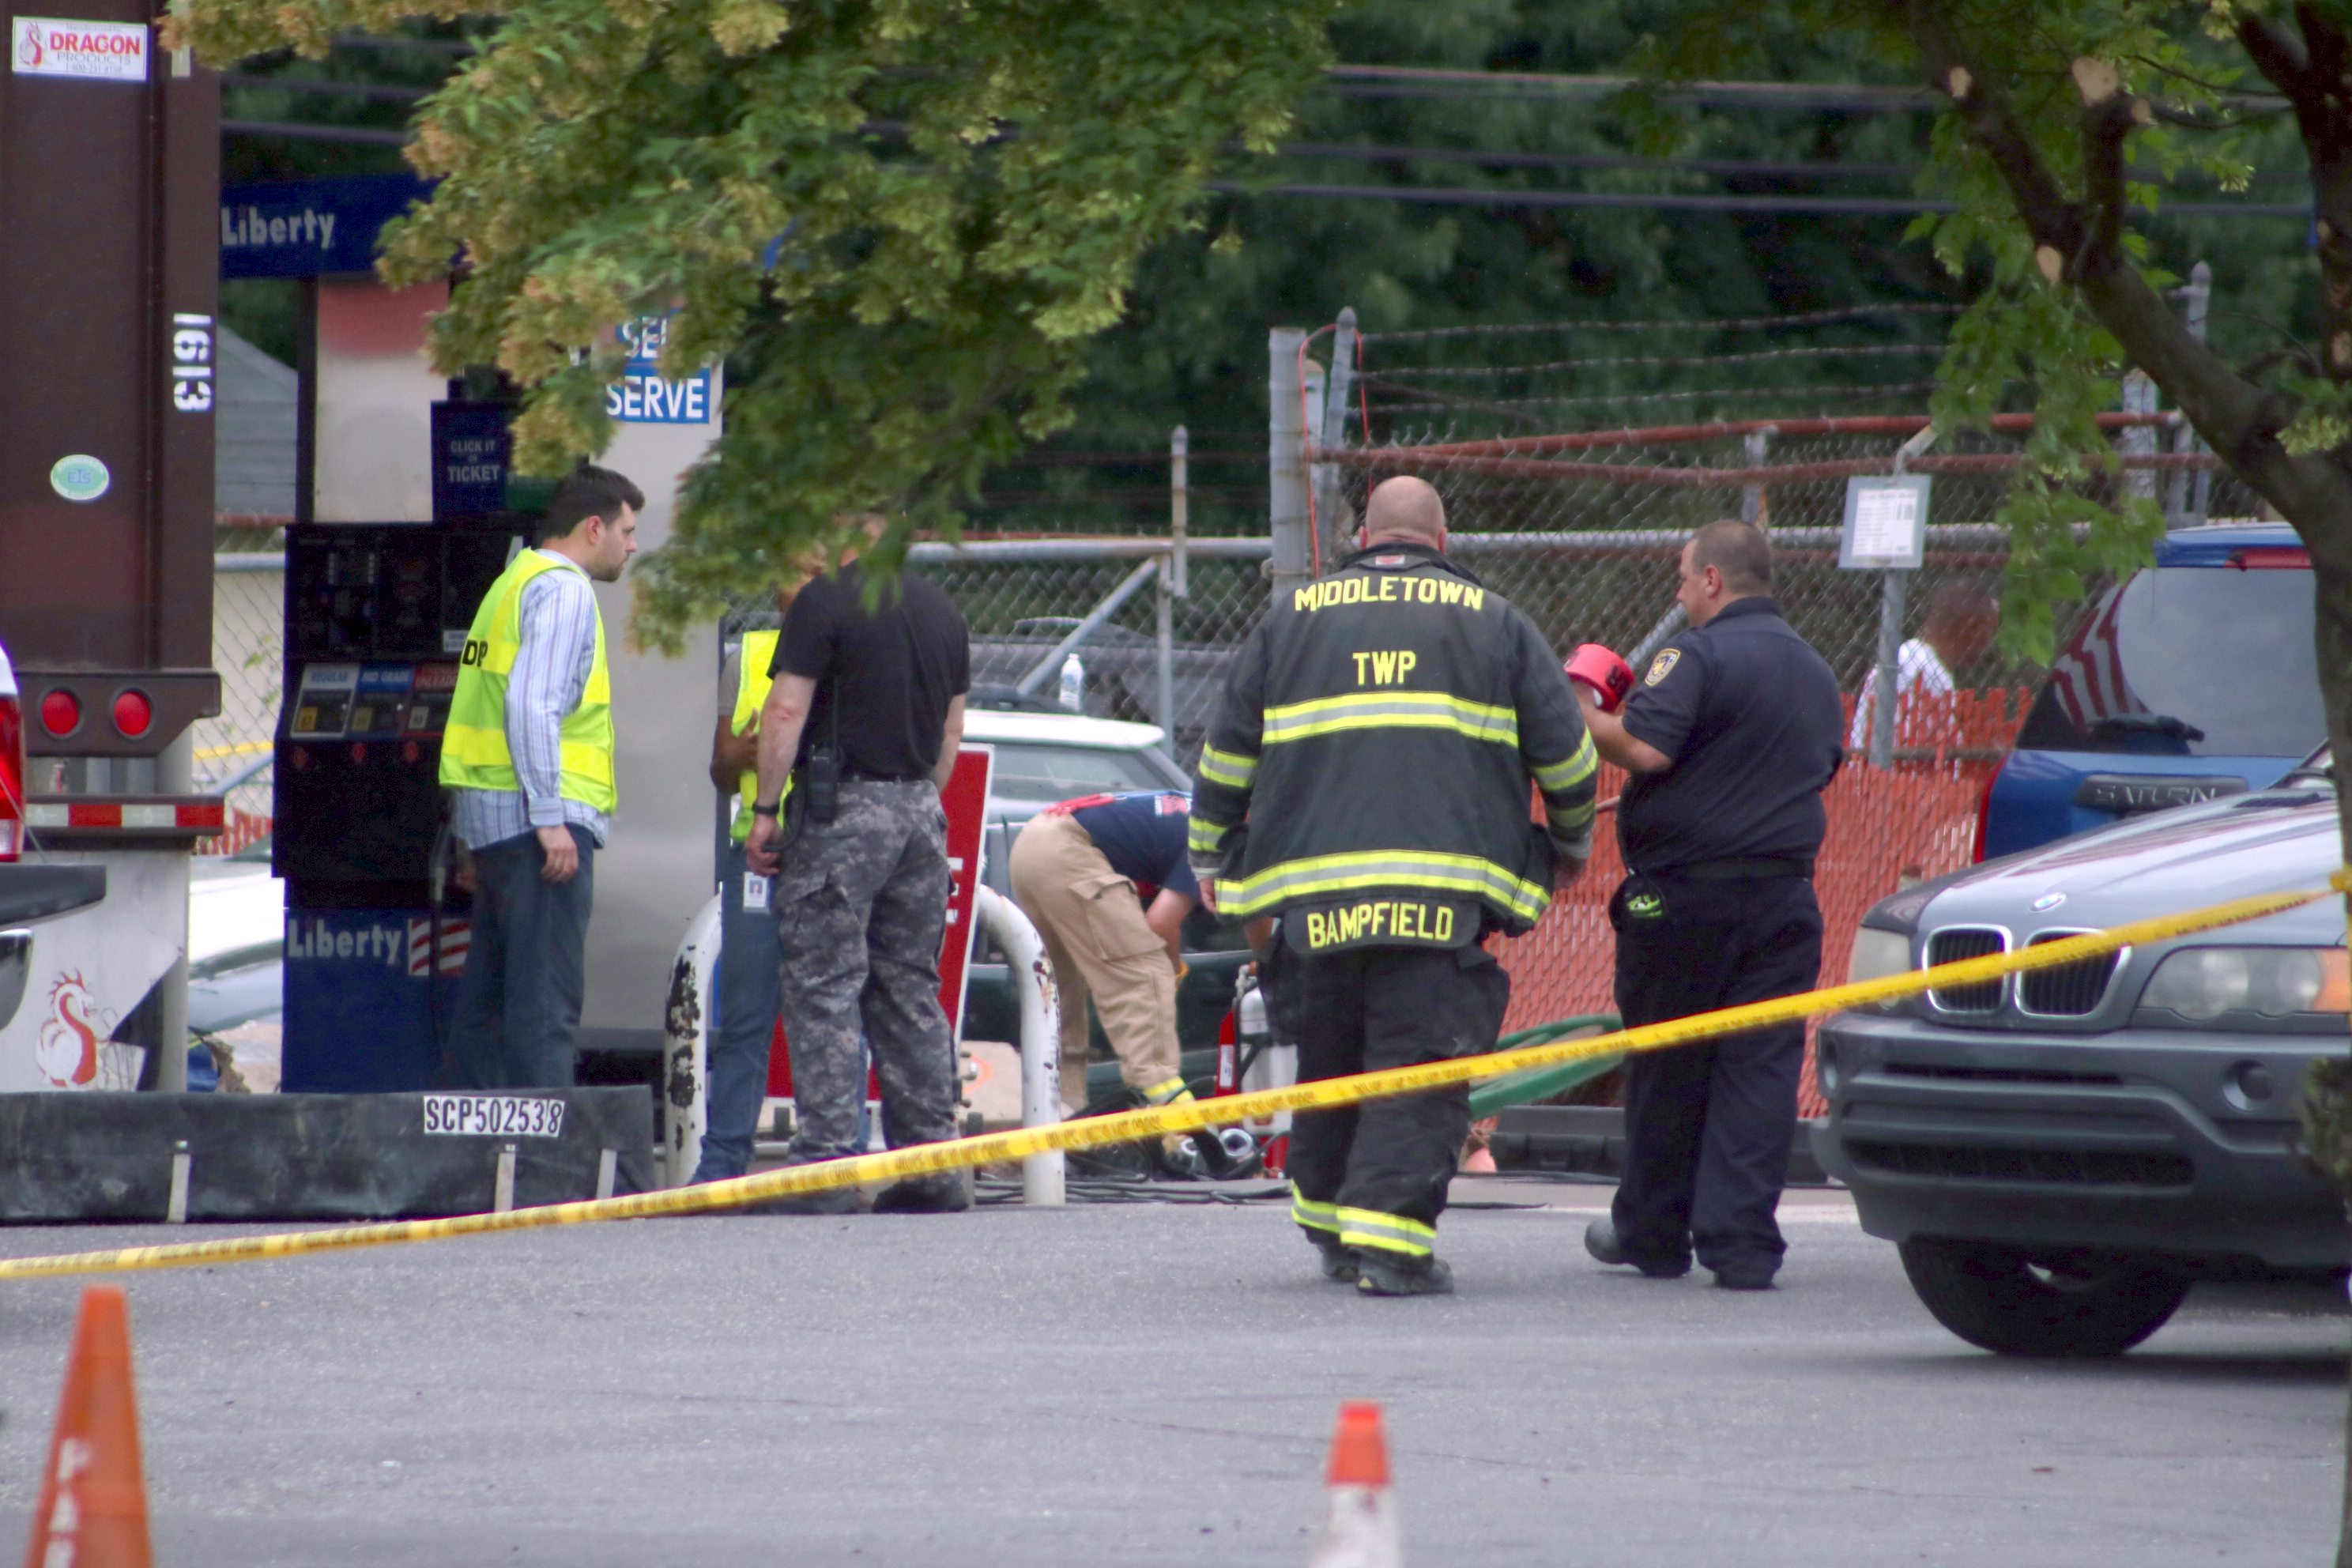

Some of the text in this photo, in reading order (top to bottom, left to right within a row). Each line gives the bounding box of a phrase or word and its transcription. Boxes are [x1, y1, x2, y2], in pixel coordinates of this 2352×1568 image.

[50, 30, 141, 55] DRAGON
[57, 51, 130, 65] PRODUCTS
[220, 205, 335, 250] Liberty
[173, 313, 211, 412] 1613
[606, 375, 704, 419] SERVE
[450, 439, 482, 453] CLICK
[447, 465, 501, 482] TICKET
[1295, 576, 1483, 612] MIDDLETOWN
[1352, 650, 1416, 686] TWP
[2095, 784, 2216, 805] SATURN
[288, 918, 401, 965] Liberty
[1307, 902, 1453, 948] BAMPFIELD
[425, 1098, 563, 1134] SCP502538
